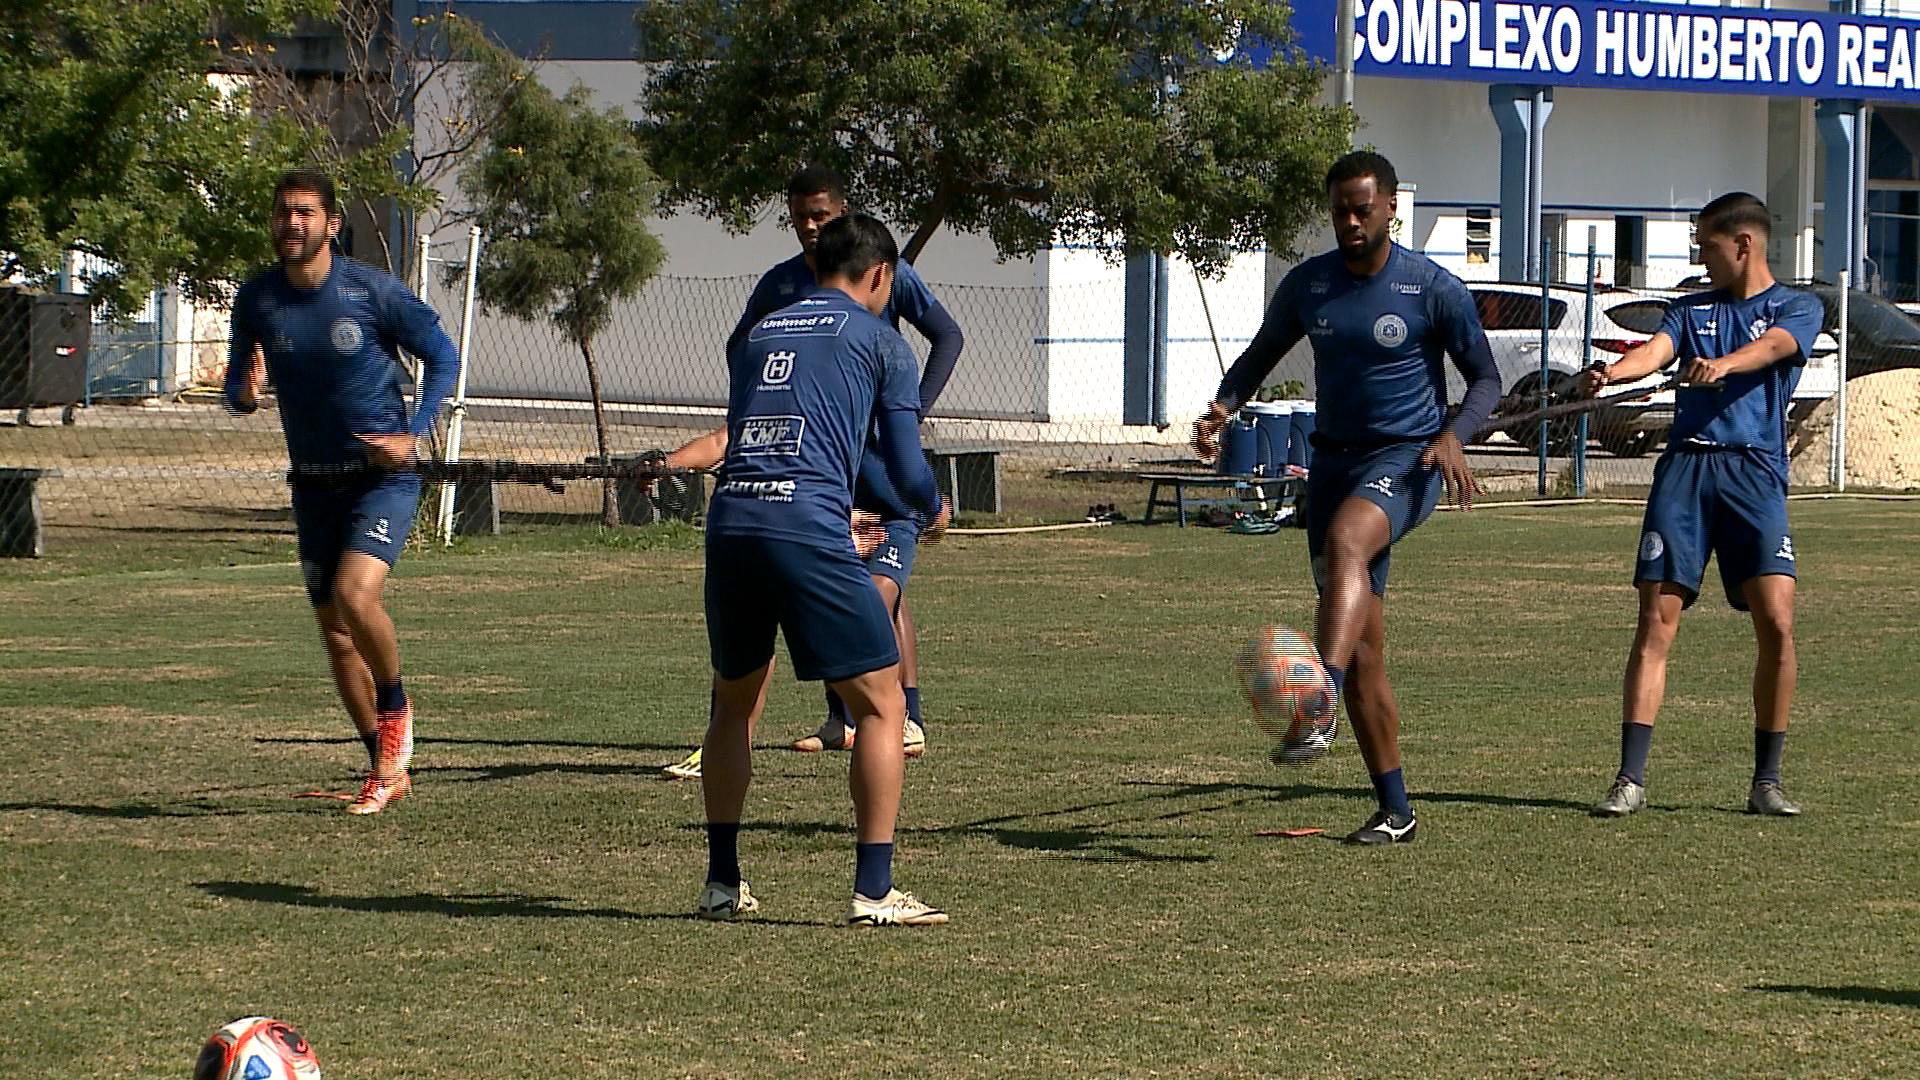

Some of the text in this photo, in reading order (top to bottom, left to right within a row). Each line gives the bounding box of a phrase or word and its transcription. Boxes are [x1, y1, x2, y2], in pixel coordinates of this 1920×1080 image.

[1595, 9, 1825, 85] HUMBERTO
[1836, 24, 1920, 90] REA
[762, 316, 818, 329] Unimed
